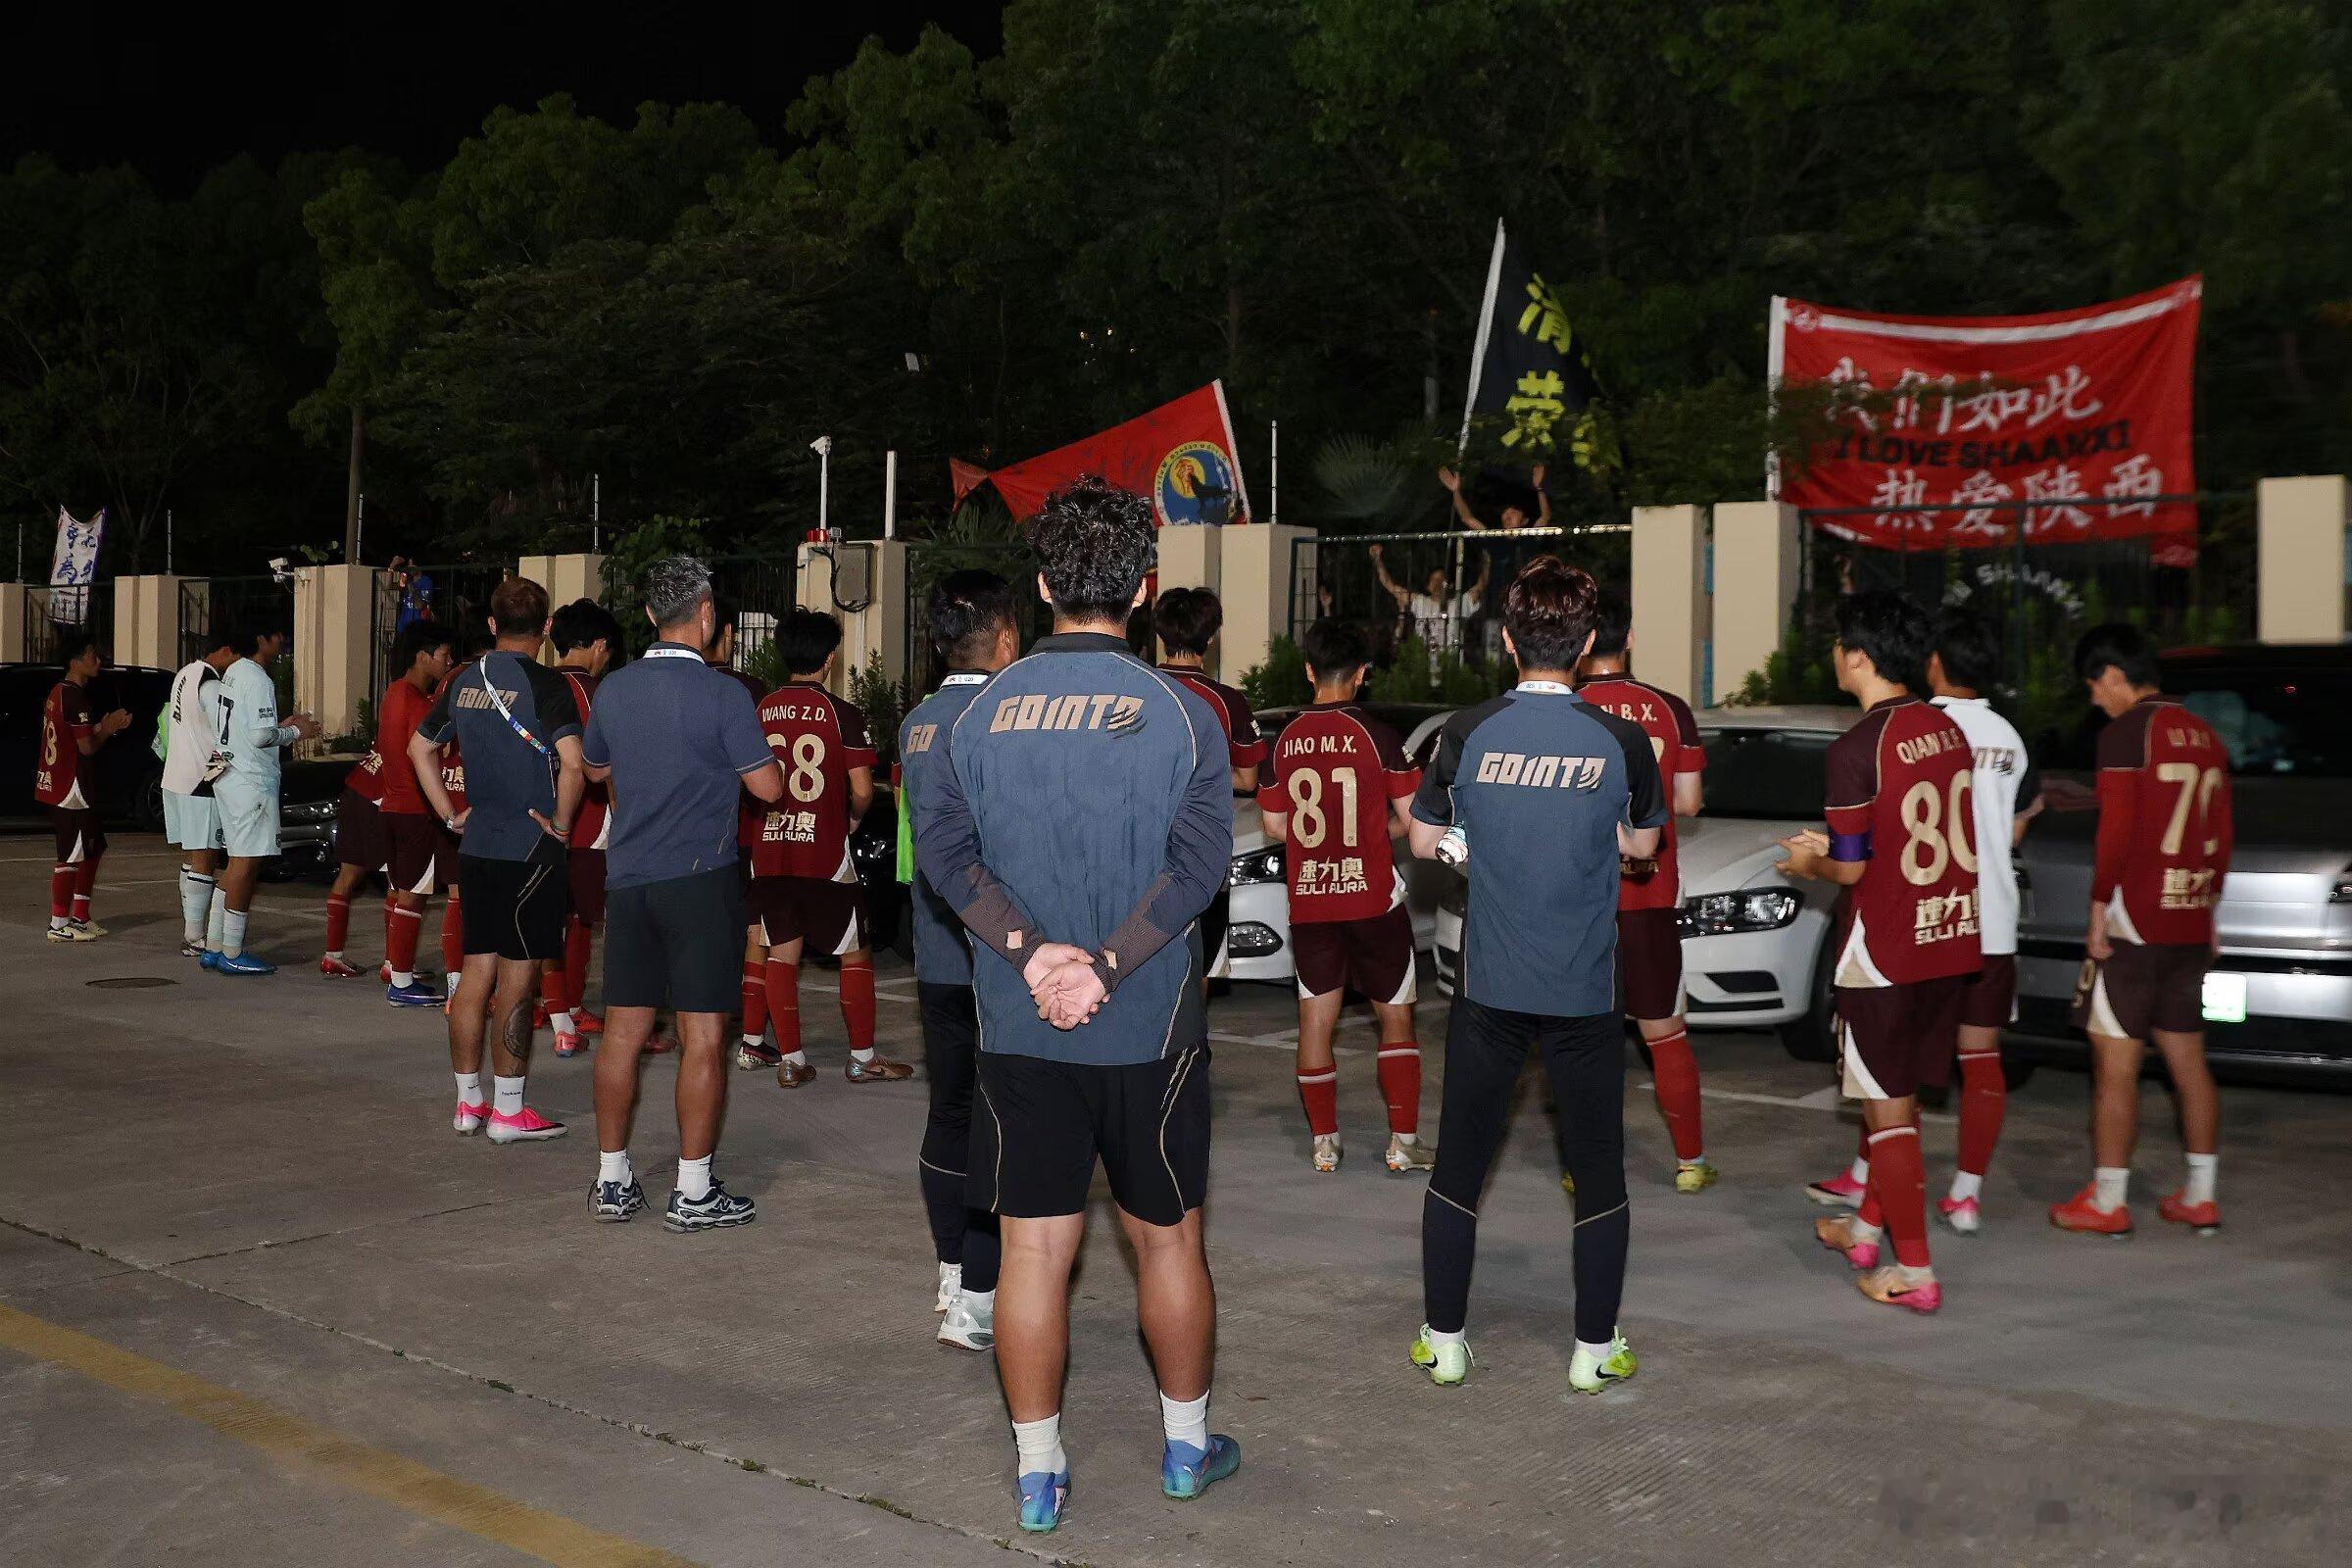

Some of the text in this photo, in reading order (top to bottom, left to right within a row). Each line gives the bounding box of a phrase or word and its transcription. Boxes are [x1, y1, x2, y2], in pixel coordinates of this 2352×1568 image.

[1860, 436, 1952, 467] LOVE
[1958, 419, 2130, 469] SHAANXI
[1870, 453, 2163, 536] 热爱陕西
[761, 705, 827, 722] WANG Z. D.
[1641, 703, 1658, 721] X.
[1283, 735, 1357, 759] JIAO M. X.
[1288, 766, 1357, 849] 81
[1298, 856, 1366, 883] 速力奥
